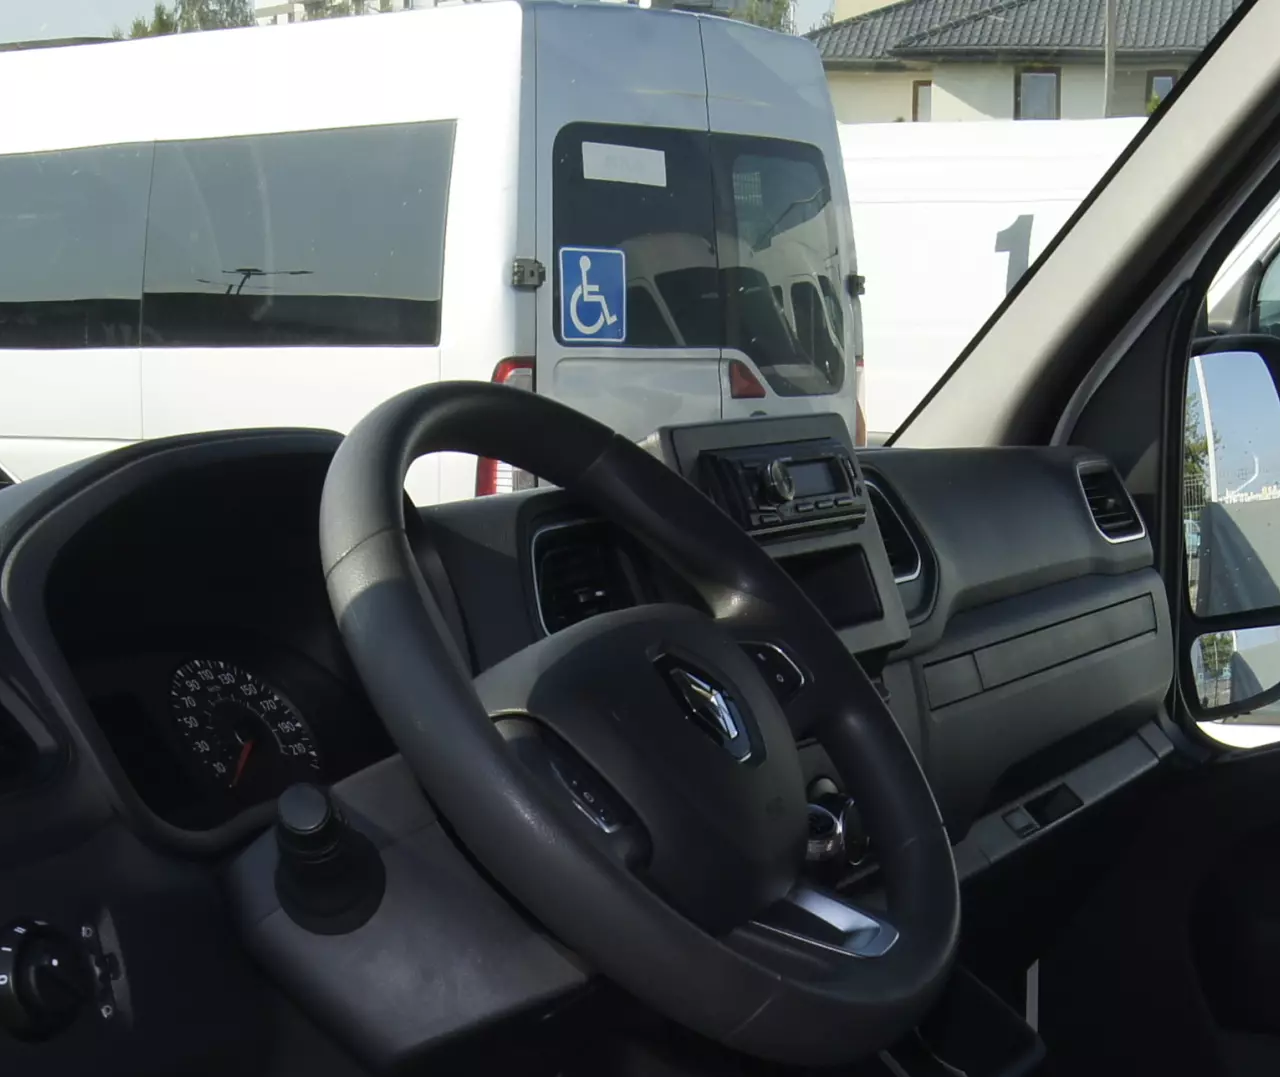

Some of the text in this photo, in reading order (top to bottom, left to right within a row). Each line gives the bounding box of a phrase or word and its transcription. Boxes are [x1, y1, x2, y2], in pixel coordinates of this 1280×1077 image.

[197, 668, 215, 681] 110
[217, 672, 236, 685] 130
[185, 679, 201, 692] 90
[240, 683, 258, 696] 150
[180, 696, 197, 709] 70
[259, 700, 278, 711] 170
[183, 715, 199, 729] 50
[278, 721, 296, 733] 190
[288, 742, 306, 756] 210
